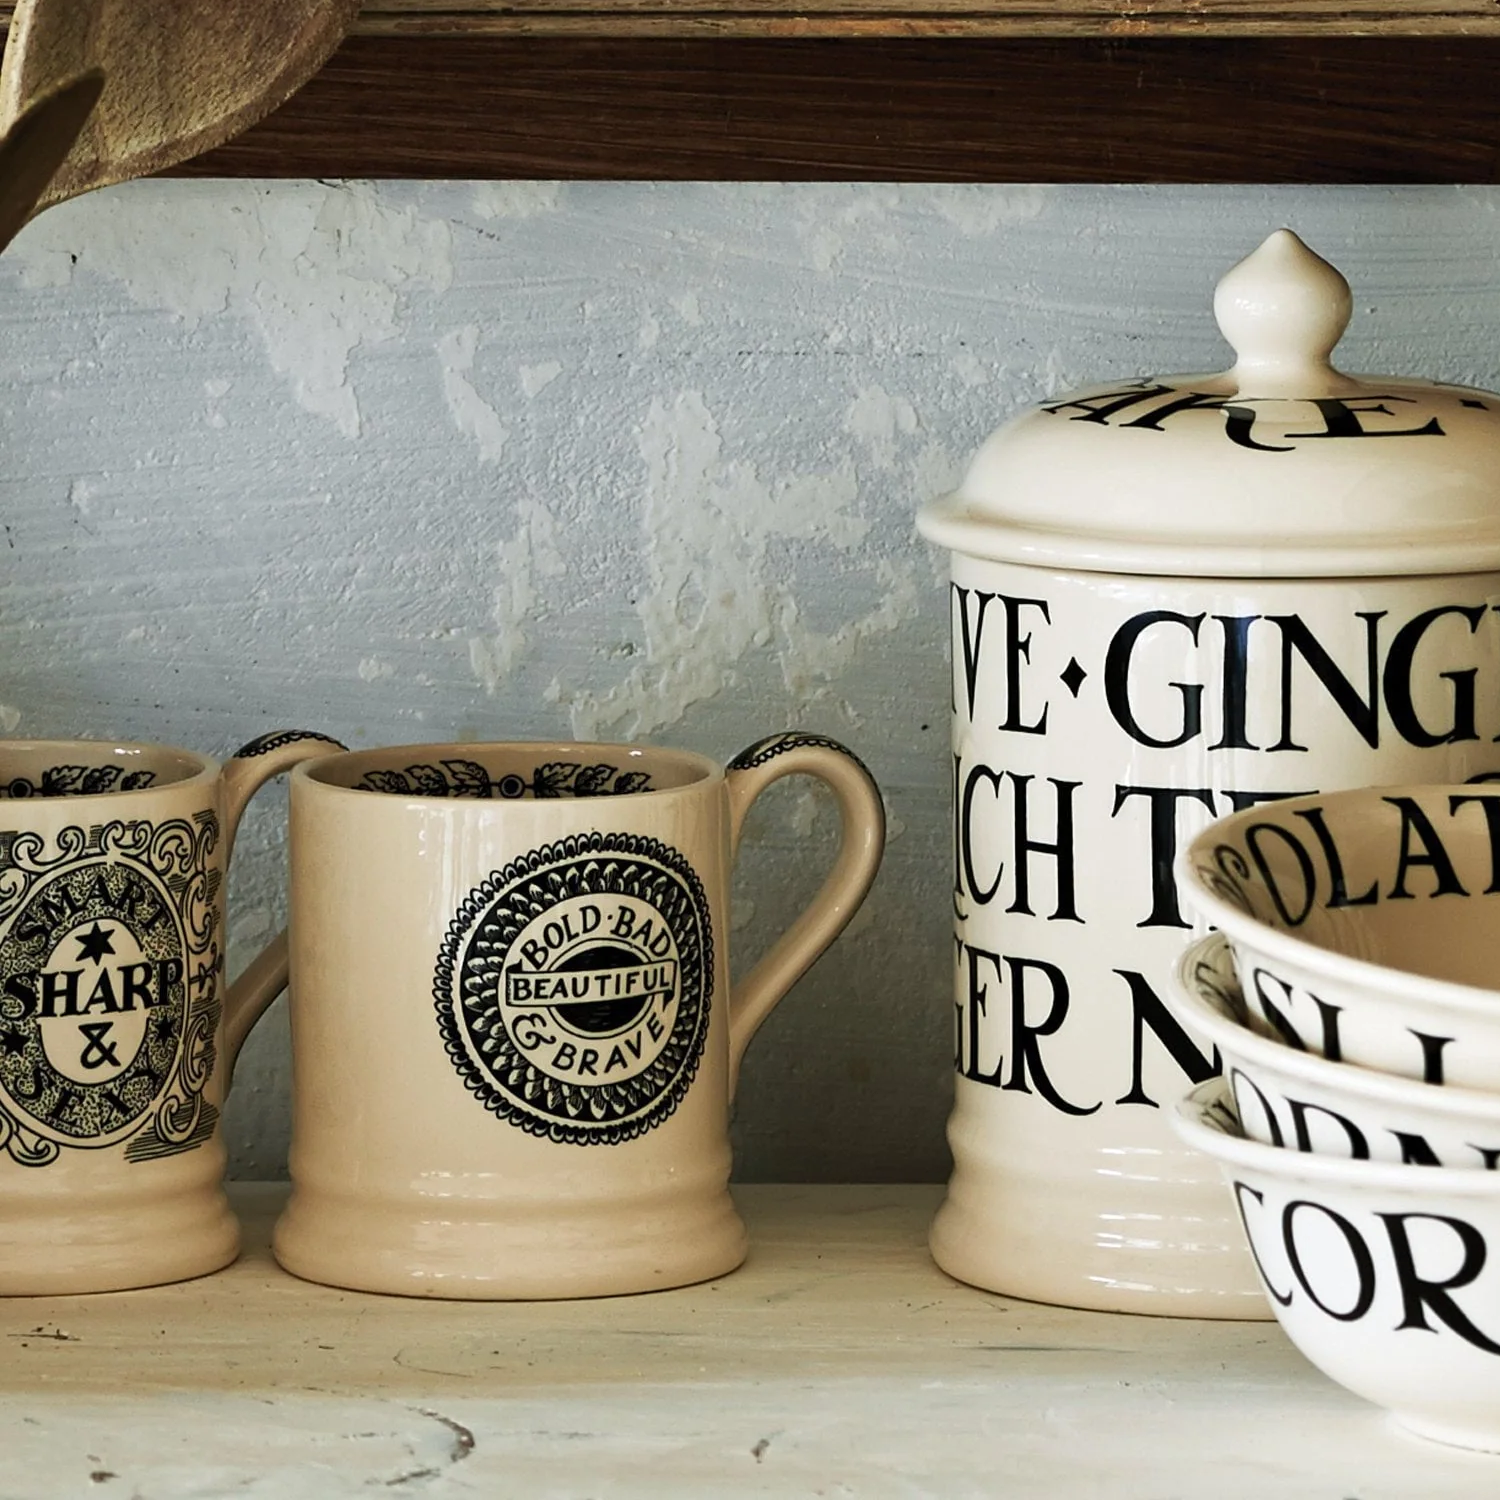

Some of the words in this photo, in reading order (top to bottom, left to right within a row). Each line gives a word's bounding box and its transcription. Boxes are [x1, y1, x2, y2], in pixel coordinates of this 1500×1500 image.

[951, 581, 1051, 736] VE
[953, 754, 1086, 924] ICH
[16, 874, 171, 955] SMART
[4, 957, 184, 1020] SHARP
[513, 967, 669, 1000] BEAUTIFUL
[78, 1021, 121, 1069] &
[511, 1013, 557, 1050] &
[551, 1012, 666, 1076] BRAVE
